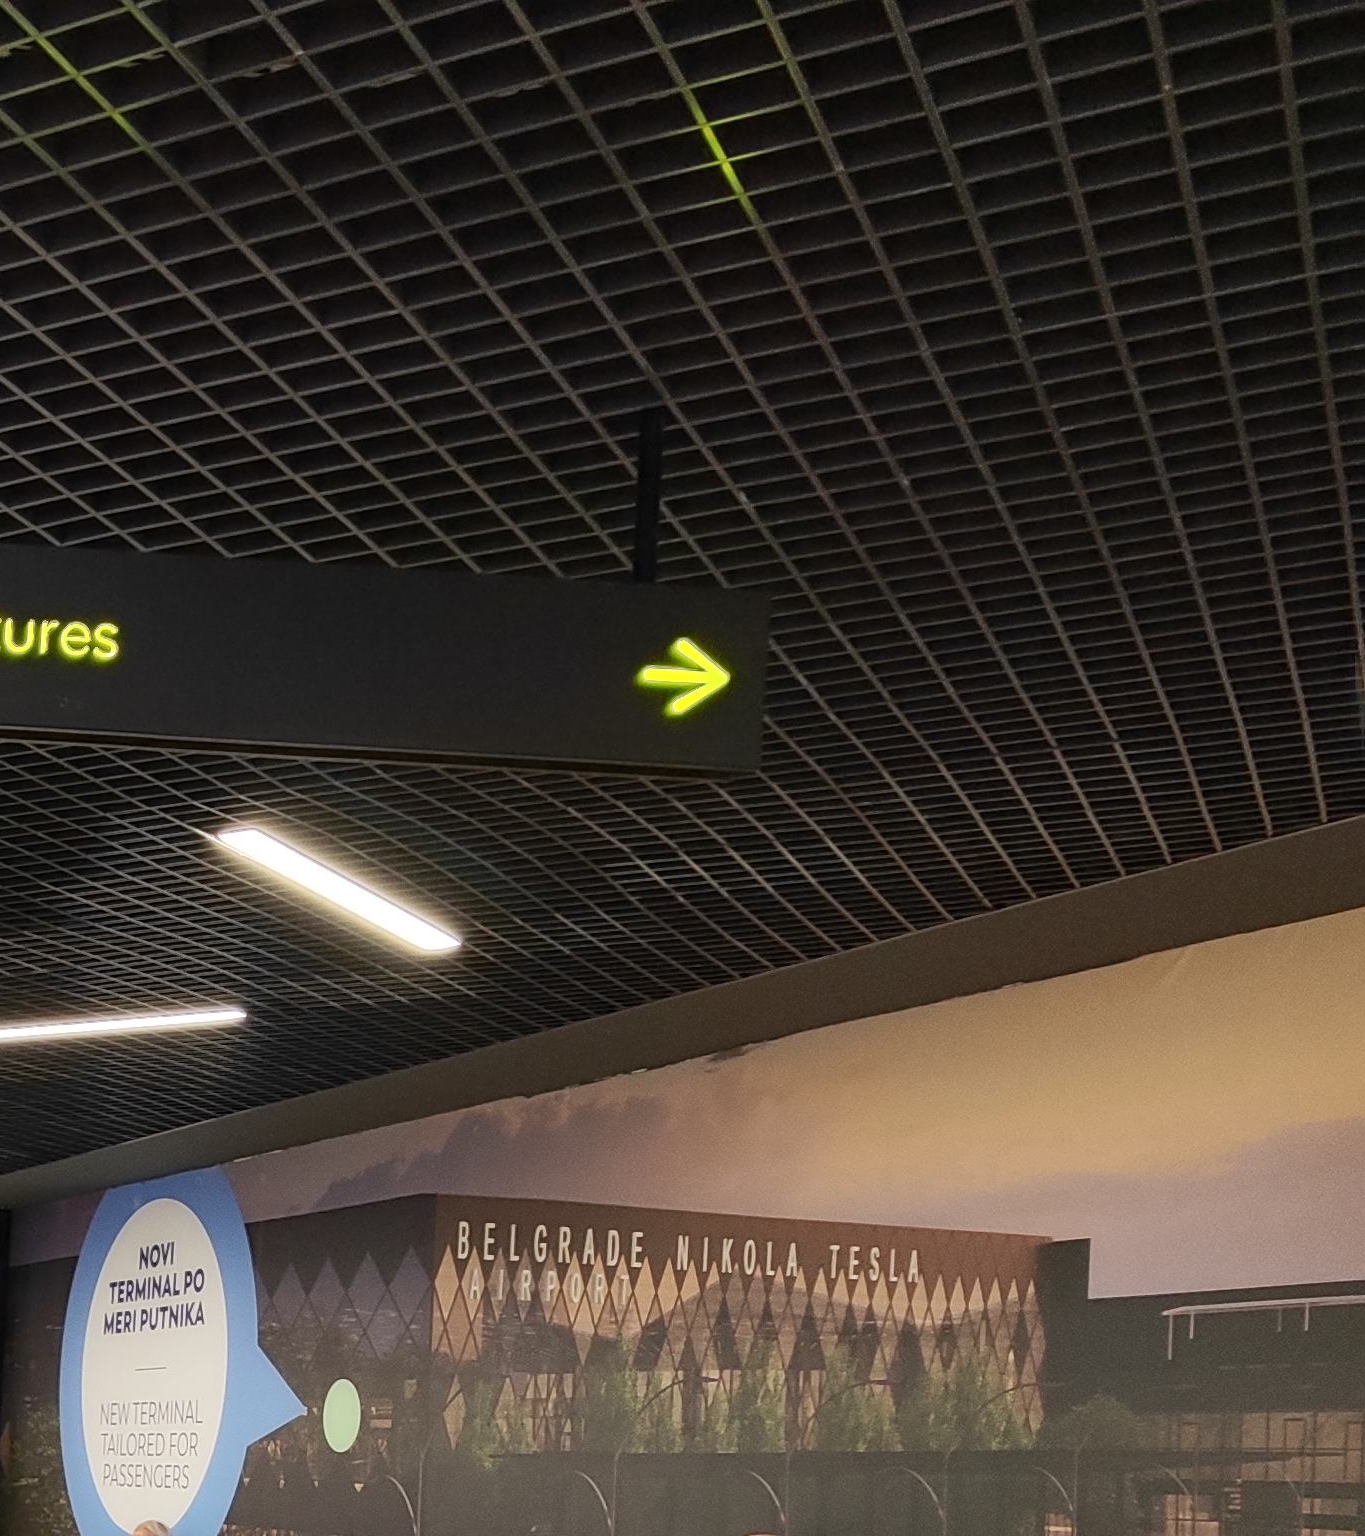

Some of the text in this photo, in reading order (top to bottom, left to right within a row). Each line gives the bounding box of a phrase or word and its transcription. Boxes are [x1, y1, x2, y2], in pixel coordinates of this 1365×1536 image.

[138, 1240, 175, 1271] NOVI
[456, 1220, 921, 1284] BELGRADE NIKOLA TESLA
[109, 1267, 206, 1305] TERMINAL PO
[469, 1267, 630, 1304] AIRPORT
[102, 1300, 206, 1336] MERI PUTNIKA
[100, 1399, 204, 1426] NEW TERMINAL
[100, 1432, 199, 1457] TAILORED FOR
[102, 1463, 190, 1490] PASSENGERS
